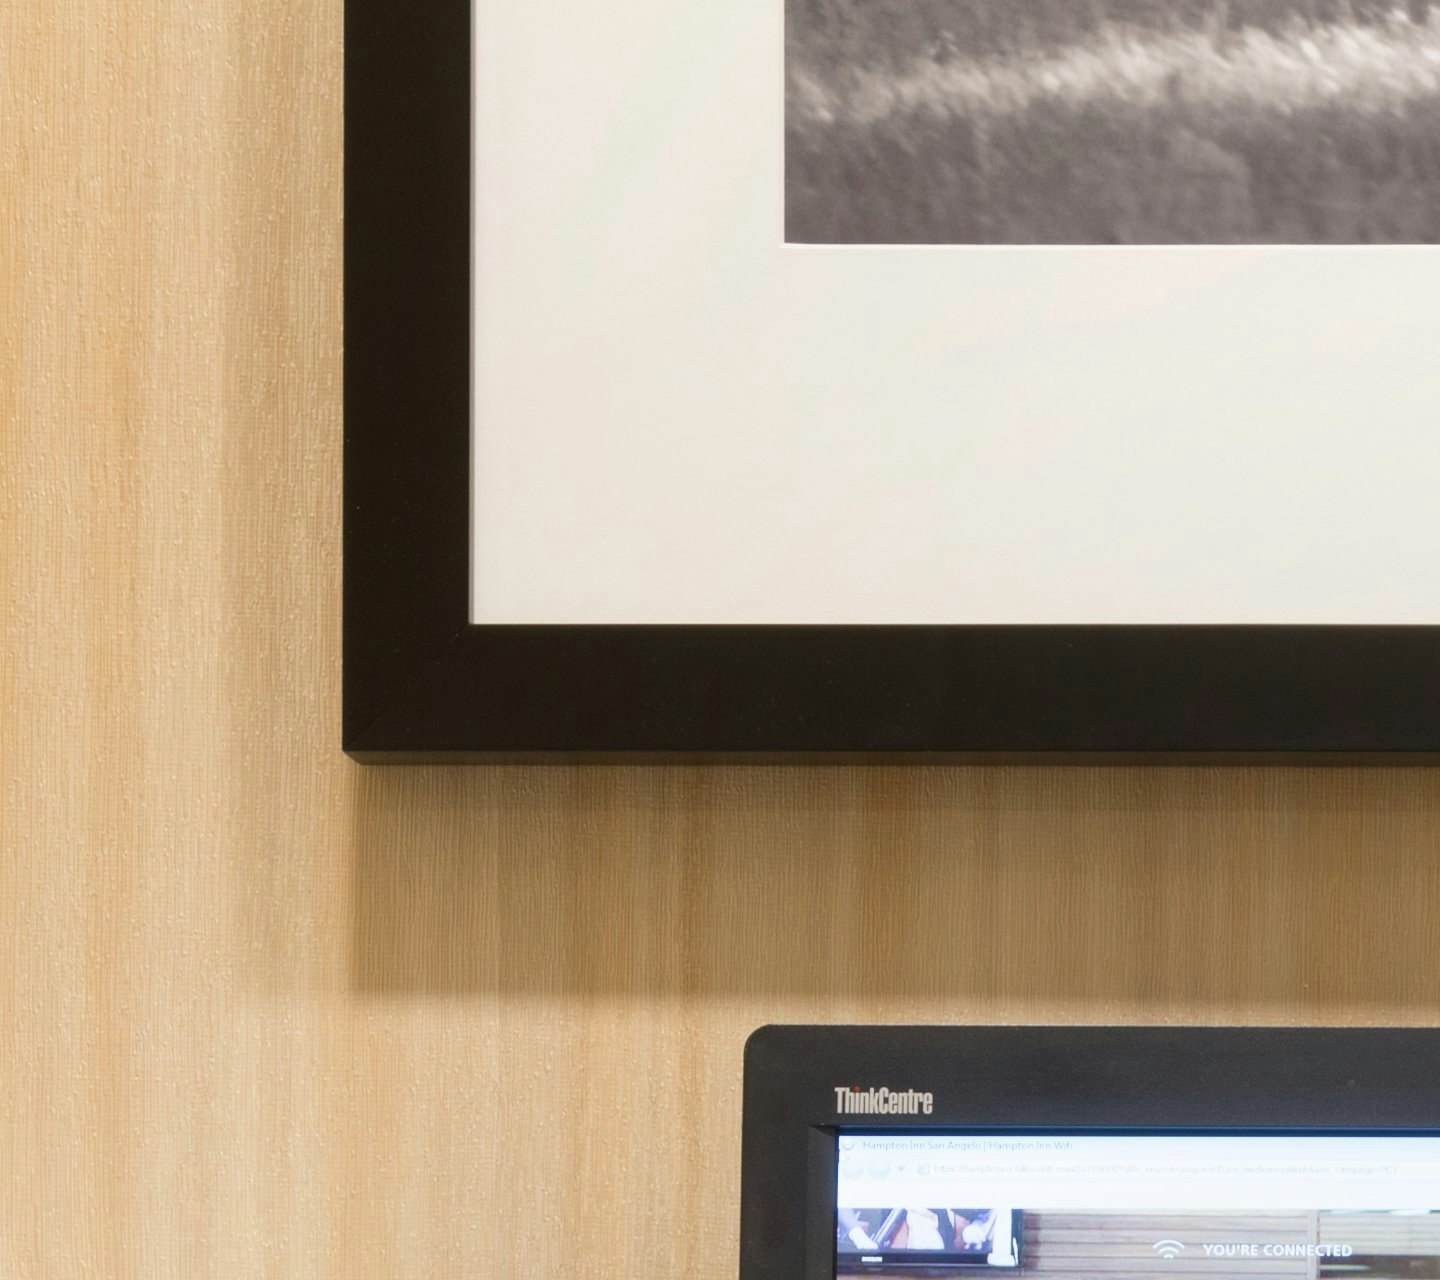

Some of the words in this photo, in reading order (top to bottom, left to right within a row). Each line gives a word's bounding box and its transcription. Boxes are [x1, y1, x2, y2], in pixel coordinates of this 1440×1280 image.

[834, 1086, 934, 1115] ThinkCentre
[863, 1140, 908, 1152] Hampton
[910, 1140, 926, 1150] Inn
[928, 1140, 946, 1150] San
[948, 1140, 981, 1152] Angelo
[989, 1140, 1035, 1152] Hampton
[1203, 1243, 1259, 1257] YOU'RE
[1263, 1243, 1353, 1257] CONNECTED
